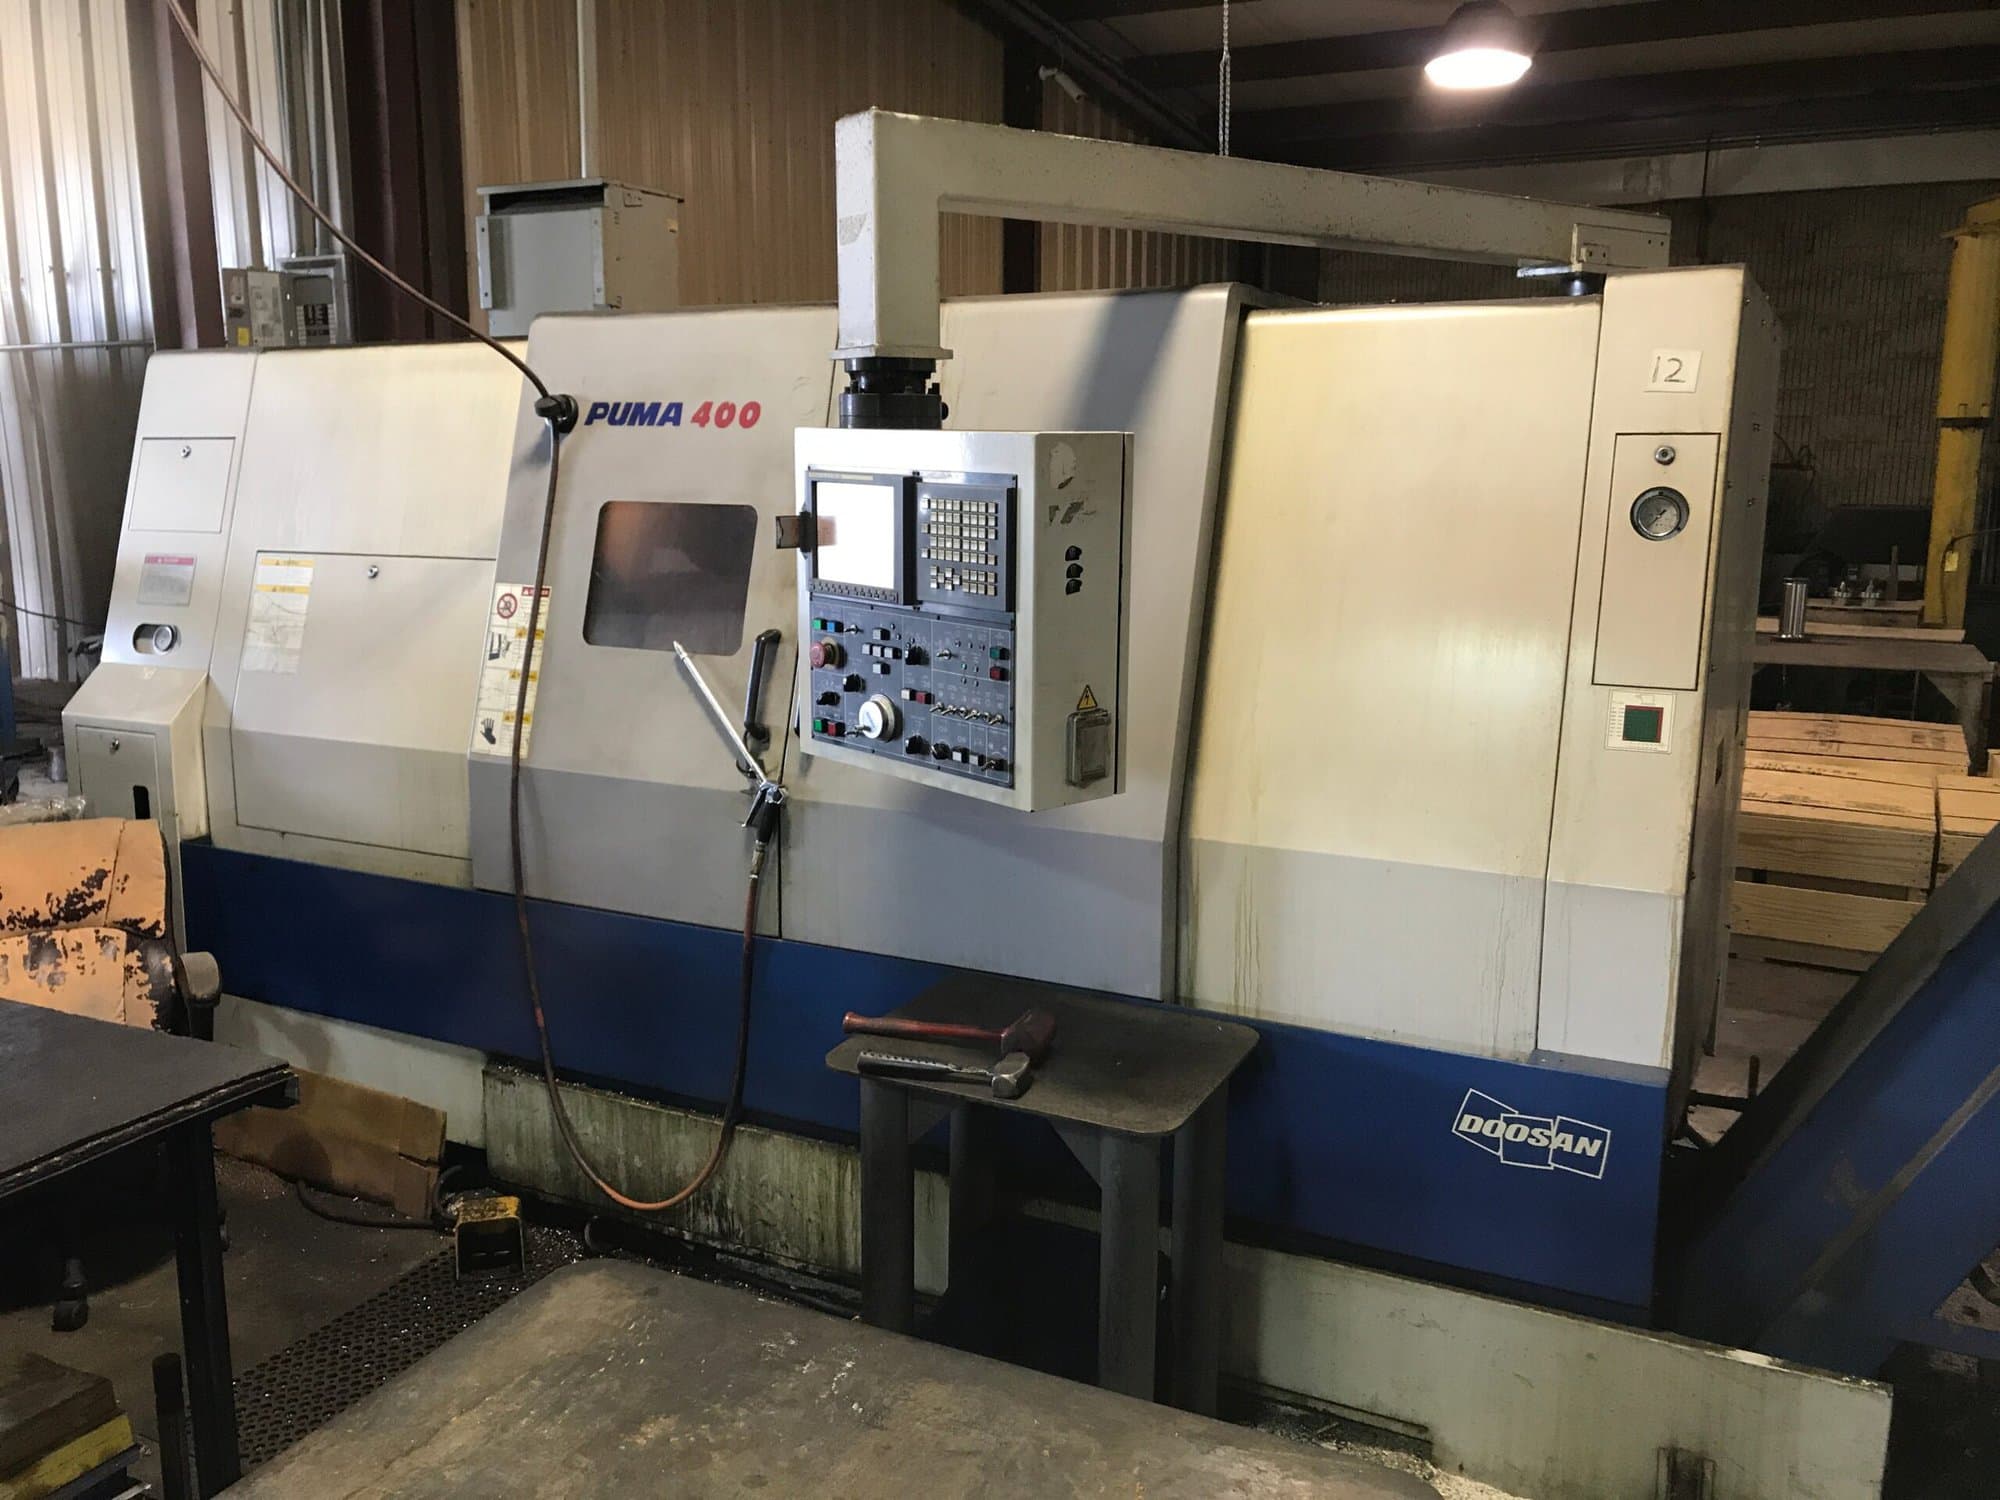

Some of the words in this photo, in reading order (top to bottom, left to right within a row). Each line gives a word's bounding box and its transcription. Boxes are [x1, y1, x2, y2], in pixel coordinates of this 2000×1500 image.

[1651, 355, 1687, 383] 12
[584, 402, 683, 426] PUMA
[690, 401, 761, 429] 400
[1458, 1113, 1603, 1157] DOOSAN
